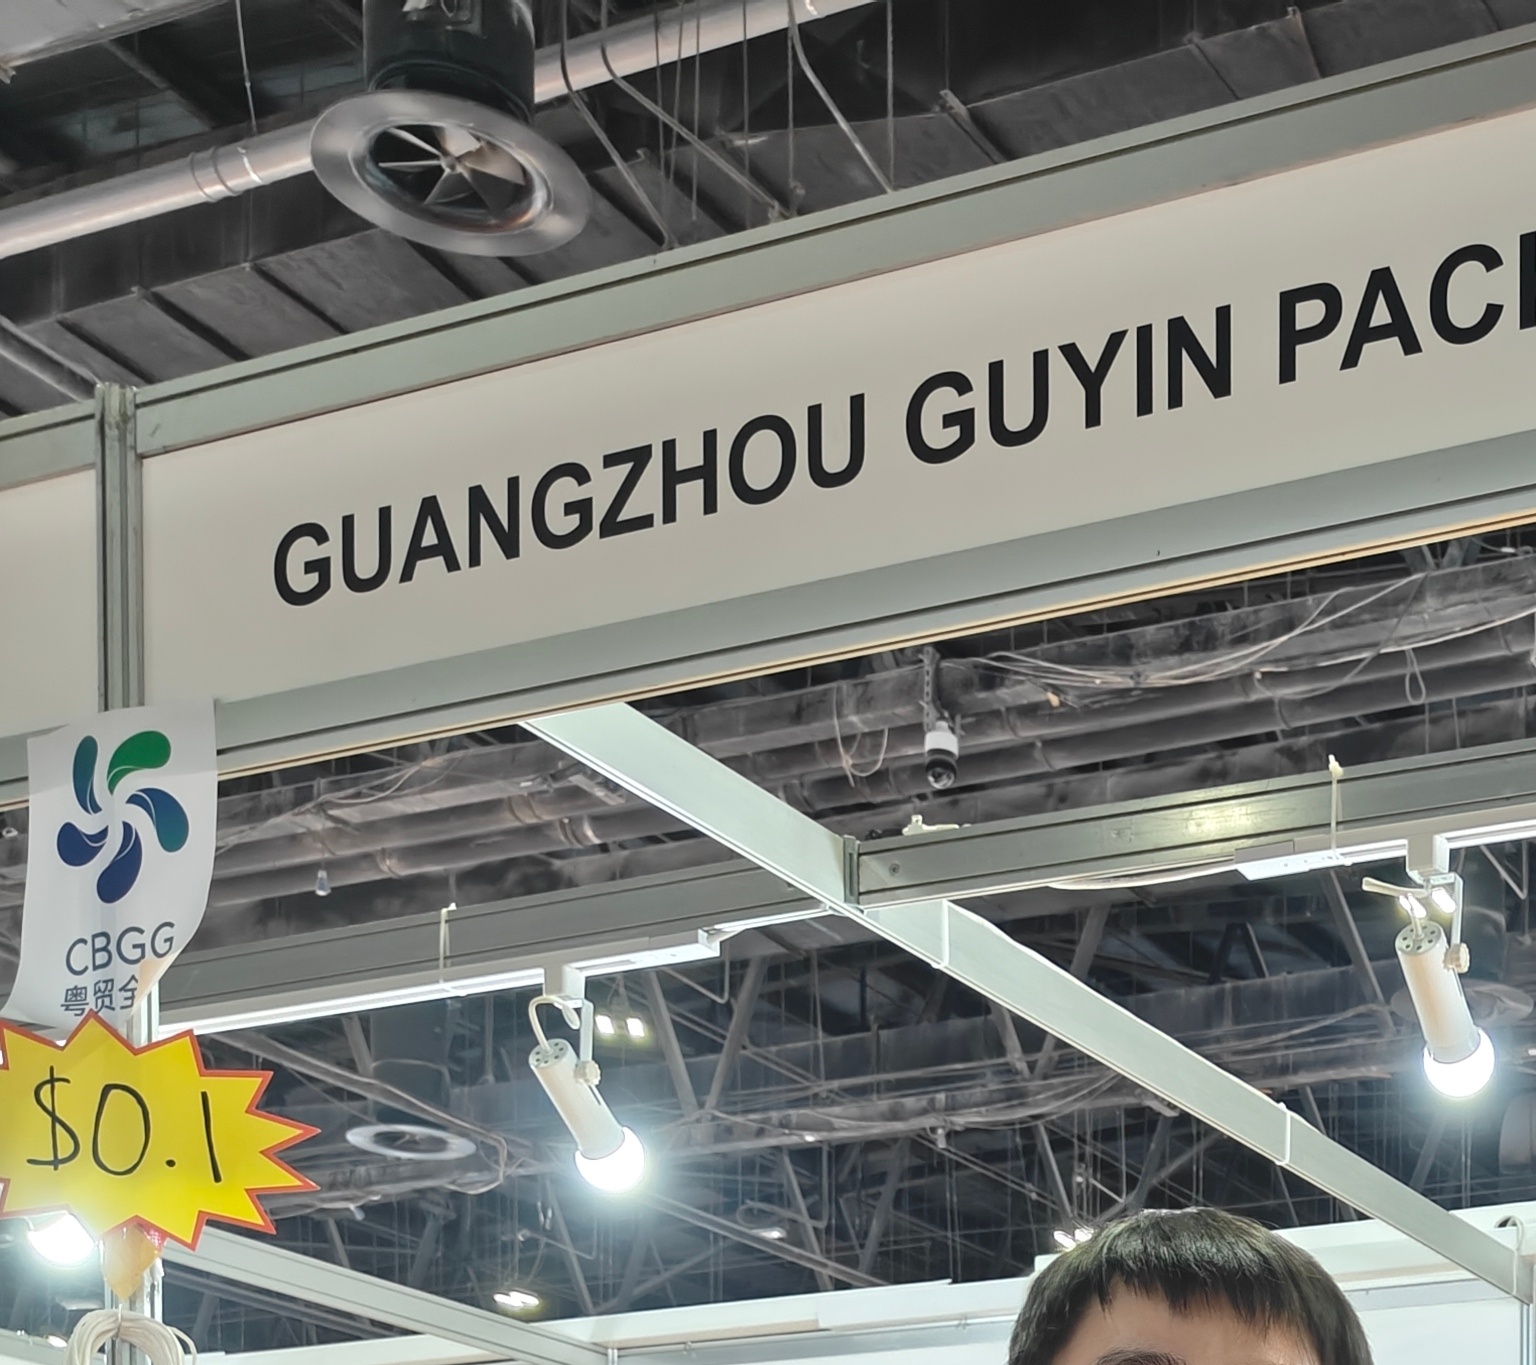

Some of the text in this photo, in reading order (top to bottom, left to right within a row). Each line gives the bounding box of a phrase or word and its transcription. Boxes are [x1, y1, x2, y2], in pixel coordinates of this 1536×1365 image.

[273, 394, 867, 606] GUANGZHOU
[905, 305, 1232, 466] GUYIN
[65, 921, 175, 976] CBGG
[26, 1066, 222, 1183] $0.1
